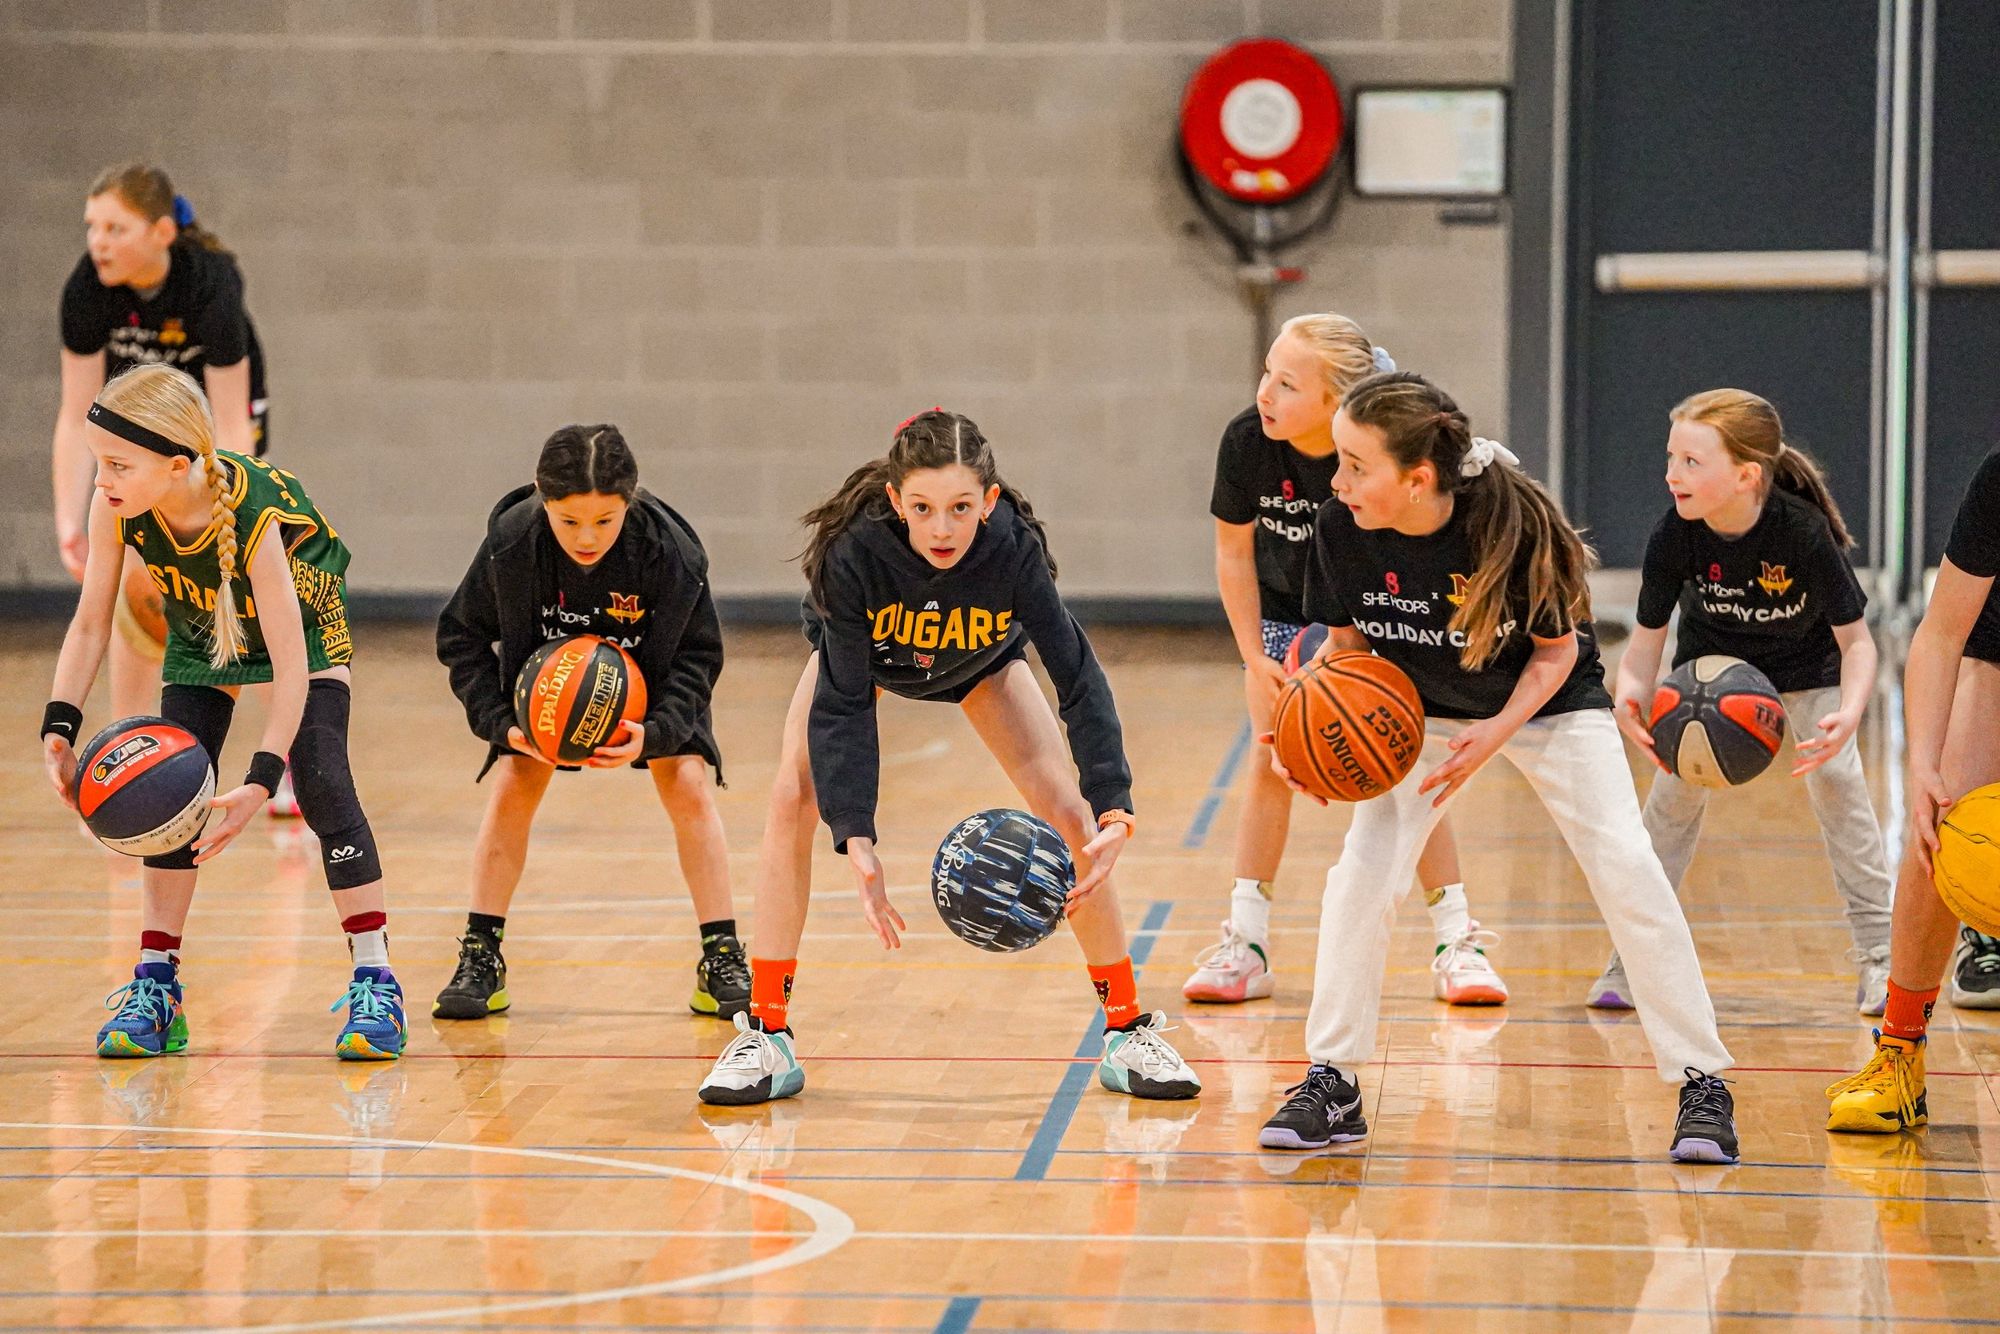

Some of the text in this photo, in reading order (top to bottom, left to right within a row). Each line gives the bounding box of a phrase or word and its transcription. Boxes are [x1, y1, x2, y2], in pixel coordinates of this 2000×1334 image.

[1259, 495, 1283, 508] SHE
[1362, 592, 1389, 607] SHE
[1390, 594, 1430, 615] HOOPS
[866, 600, 1013, 651] OUGARS
[1351, 616, 1518, 648] HOLIDAY CP
[537, 649, 586, 737] SPALDING
[936, 814, 988, 909] SPALDING
